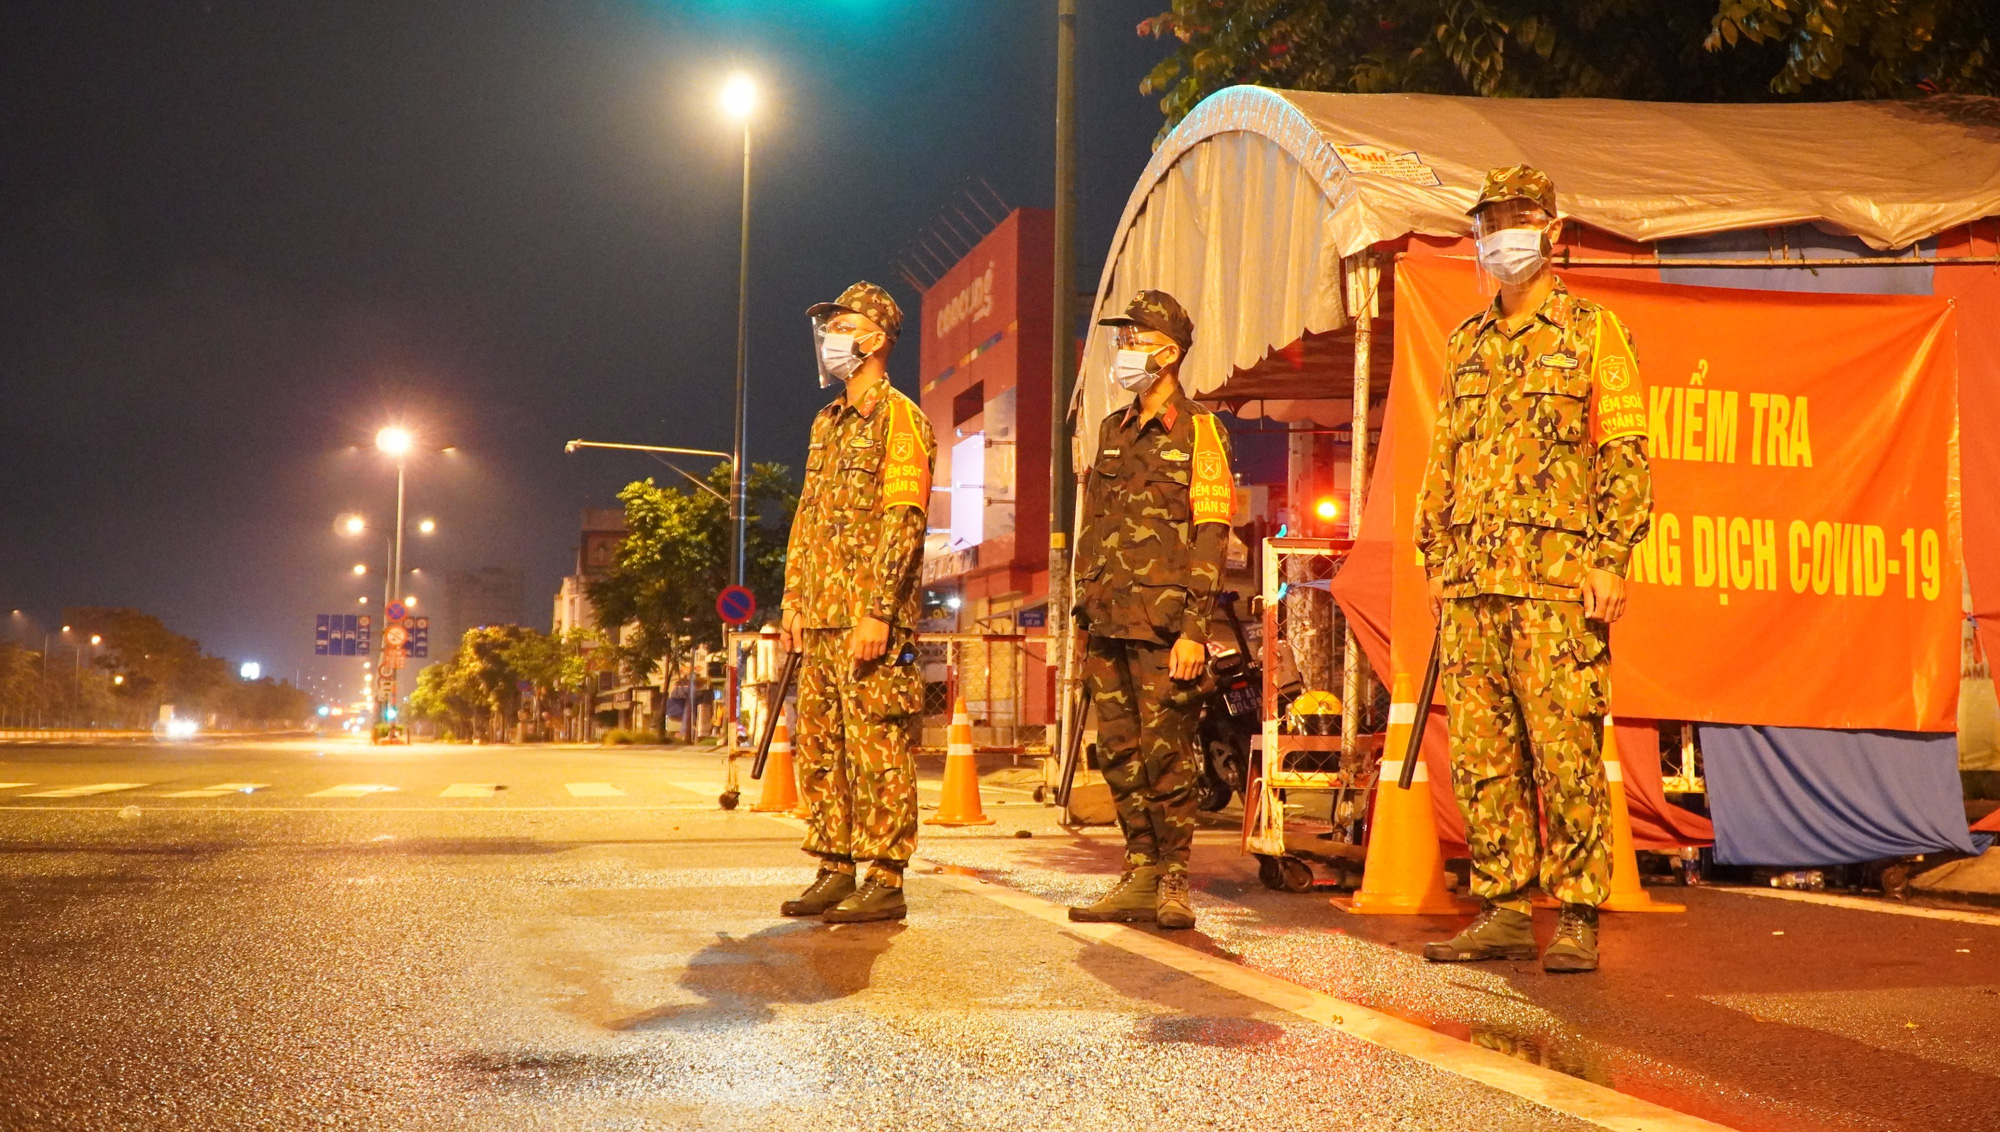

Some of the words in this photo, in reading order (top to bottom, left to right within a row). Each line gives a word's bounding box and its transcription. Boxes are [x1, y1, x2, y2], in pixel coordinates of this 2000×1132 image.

[1597, 395, 1620, 415] IỂM
[1649, 359, 1738, 463] KIỂM
[1750, 393, 1813, 467] TRA
[1600, 412, 1634, 434] QUÂN
[884, 478, 907, 497] QUÂN
[1693, 515, 1776, 605] DỊCH
[1789, 519, 1940, 601] COVID-19
